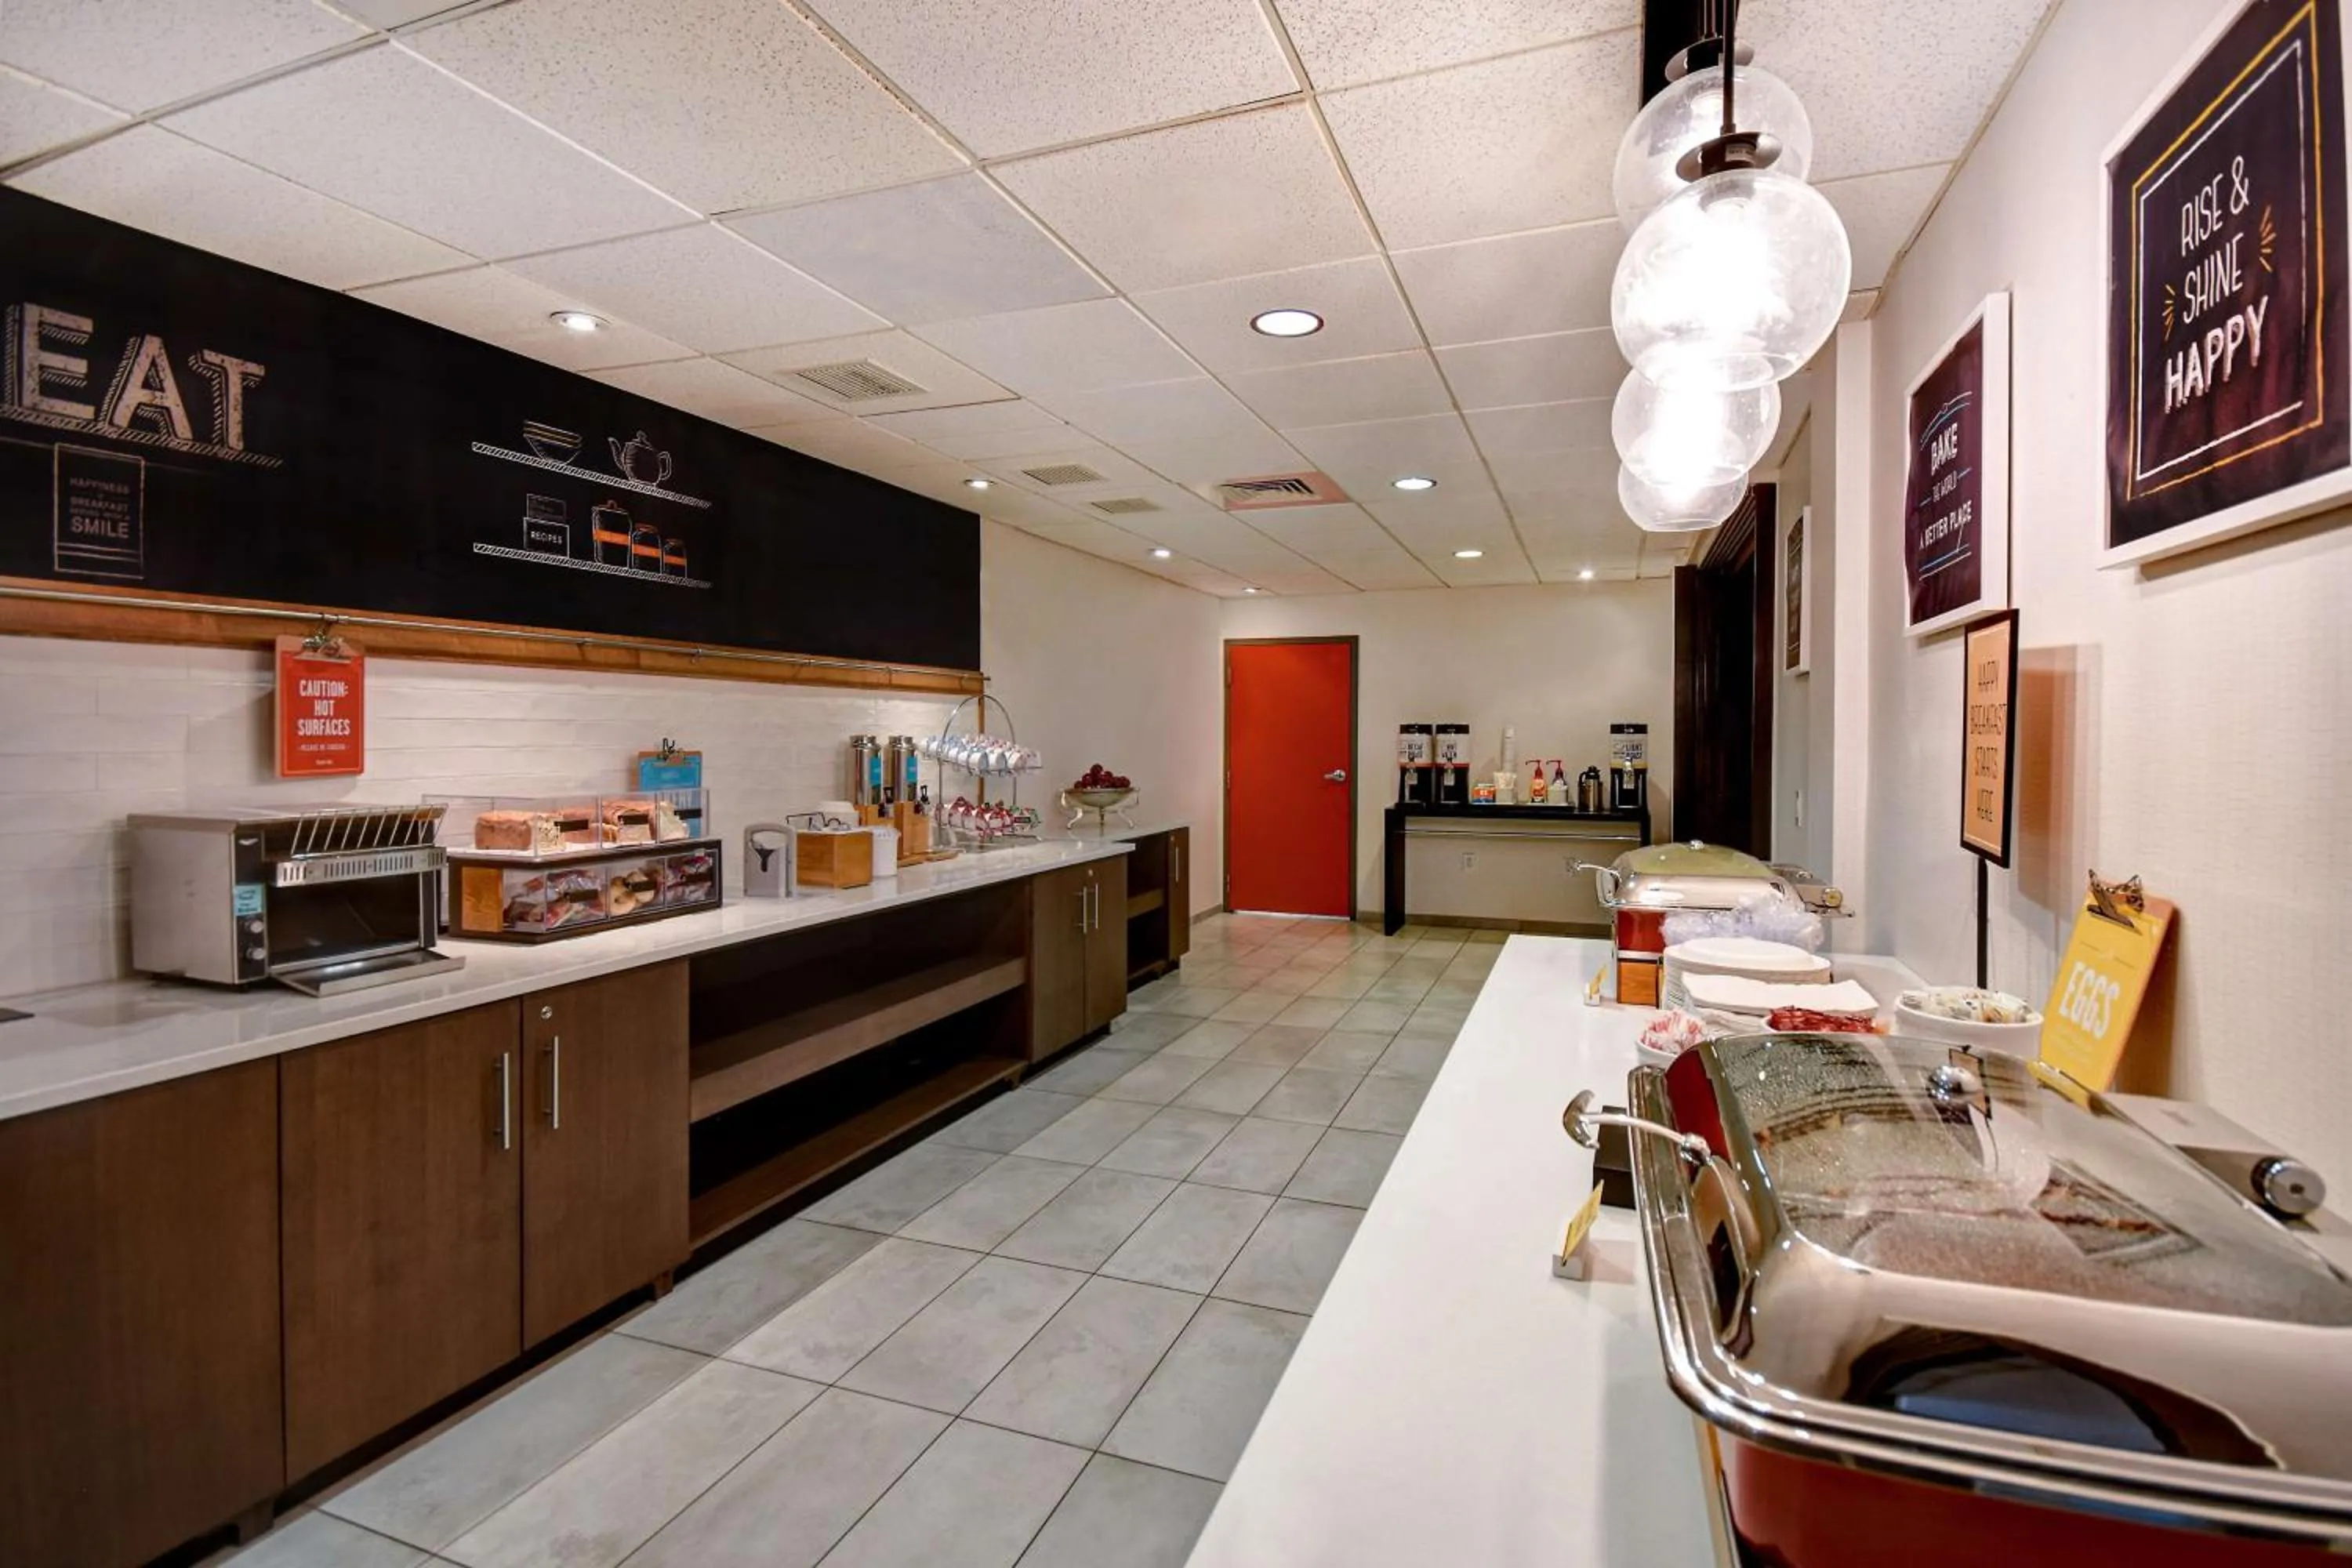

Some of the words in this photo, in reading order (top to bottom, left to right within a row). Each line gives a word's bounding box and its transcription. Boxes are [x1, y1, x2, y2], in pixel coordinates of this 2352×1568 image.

[2181, 172, 2223, 258] RISE
[2230, 154, 2250, 216] &
[2182, 231, 2245, 325] SHINE
[4, 302, 266, 452] EAT
[2165, 294, 2269, 415] HAPPY
[1931, 422, 1958, 477] BAKE
[71, 516, 130, 539] SMILE
[1925, 516, 1948, 549] BETTER
[1950, 499, 1973, 532] PLACE
[299, 680, 349, 697] CAUTION:
[314, 699, 336, 717] HOT
[297, 718, 351, 736] SURFACES
[2059, 960, 2121, 1040] EGGS
